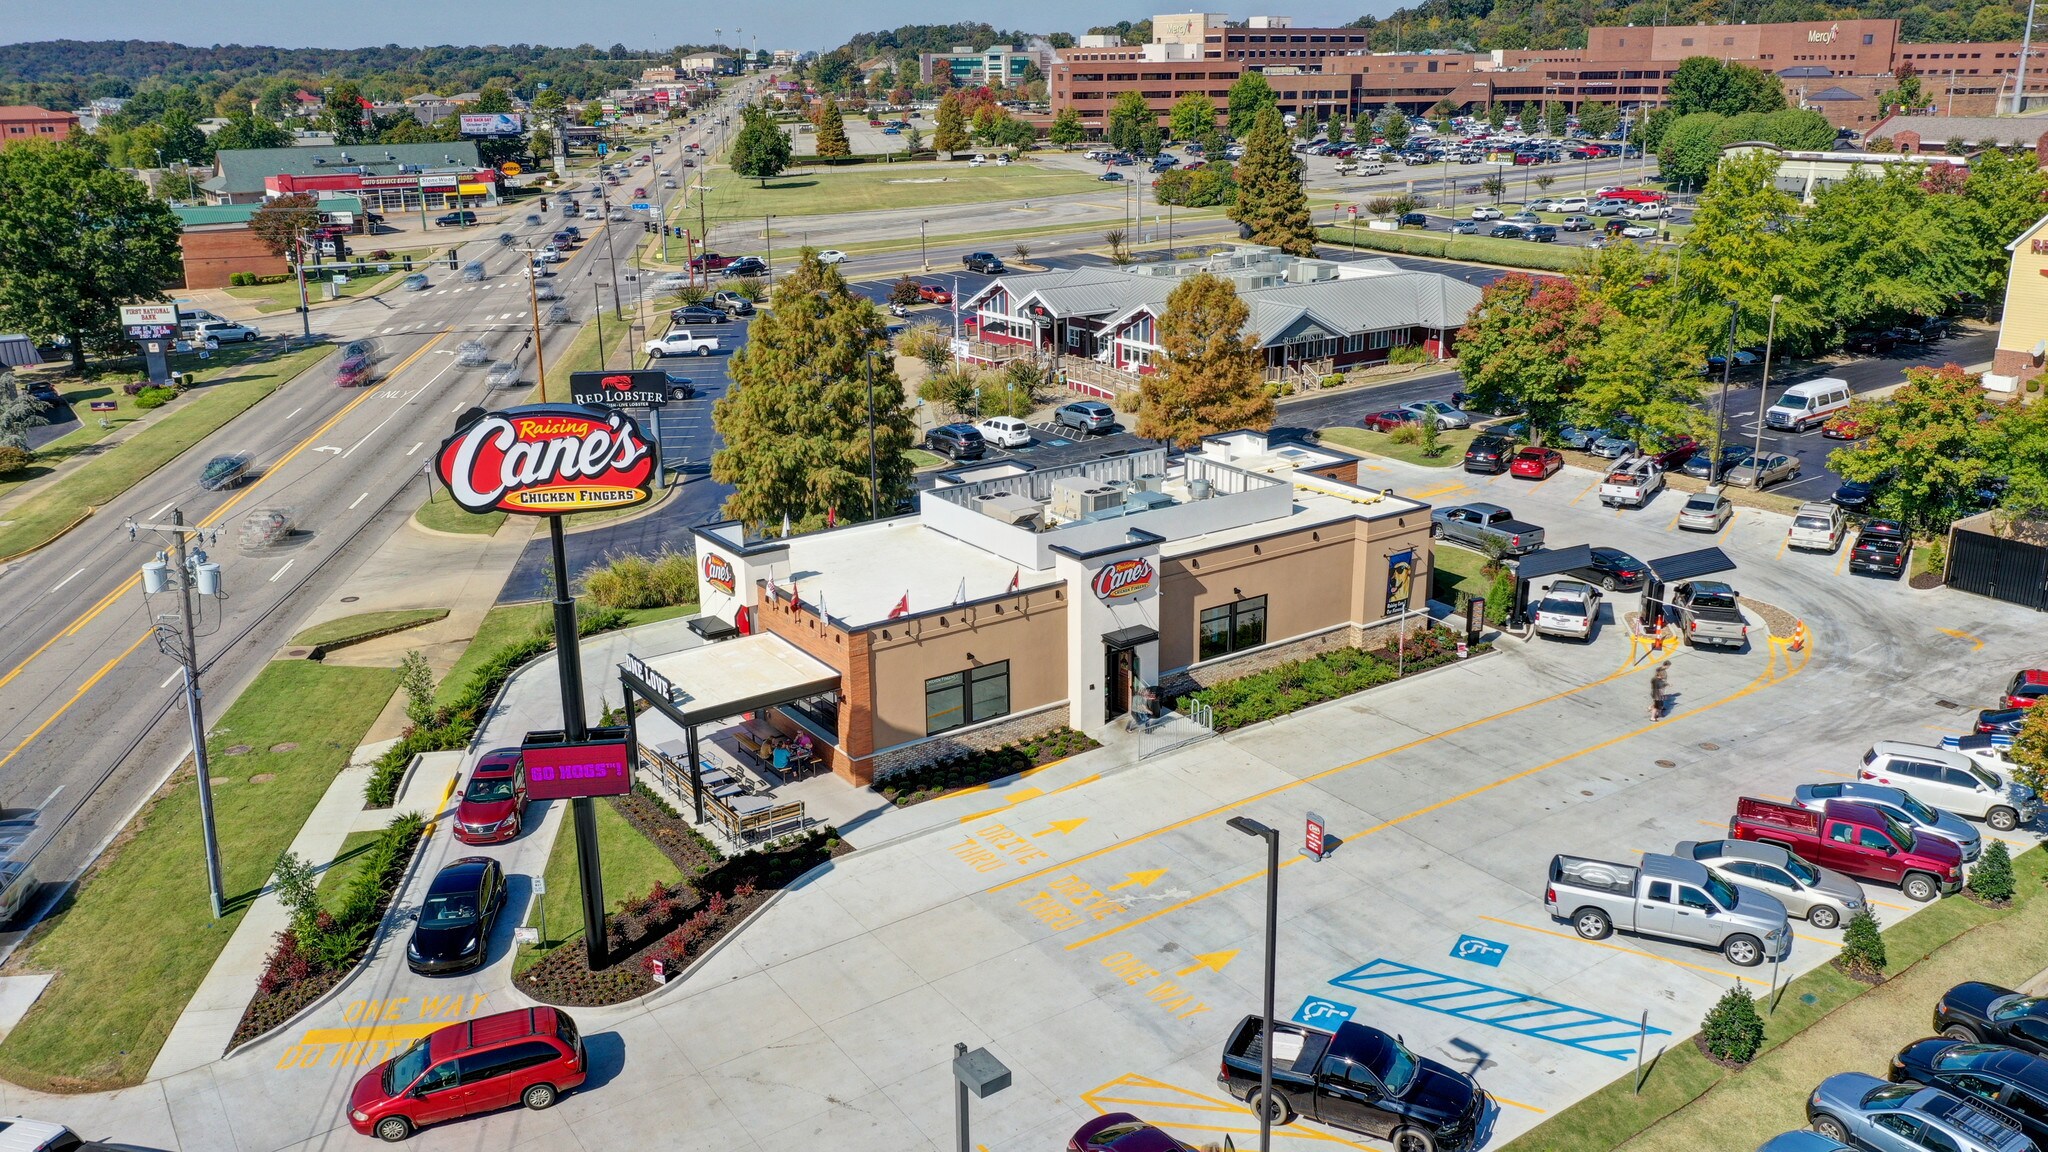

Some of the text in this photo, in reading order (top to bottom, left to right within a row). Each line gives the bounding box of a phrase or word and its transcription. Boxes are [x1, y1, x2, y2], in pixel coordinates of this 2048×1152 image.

[1167, 24, 1187, 35] Mercy
[1808, 30, 1831, 45] Mercy
[370, 390, 415, 400] ONLY
[575, 390, 663, 405] RED LOBSTER
[520, 419, 589, 438] Raising
[451, 416, 648, 507] Cane's
[520, 490, 634, 504] CHICKEN FINGERS
[703, 553, 732, 582] Cane's
[1097, 559, 1152, 599] Cane's
[626, 654, 669, 700] ONE LOVE
[531, 766, 554, 782] GO
[946, 838, 1007, 873] THRU
[976, 823, 1049, 865] DRIVE
[1017, 891, 1085, 931] THRU
[1048, 874, 1127, 920] DRIVE
[1101, 951, 1212, 1020] ONE WAY
[343, 993, 488, 1022] ONE WAY
[276, 1045, 321, 1070] DO
